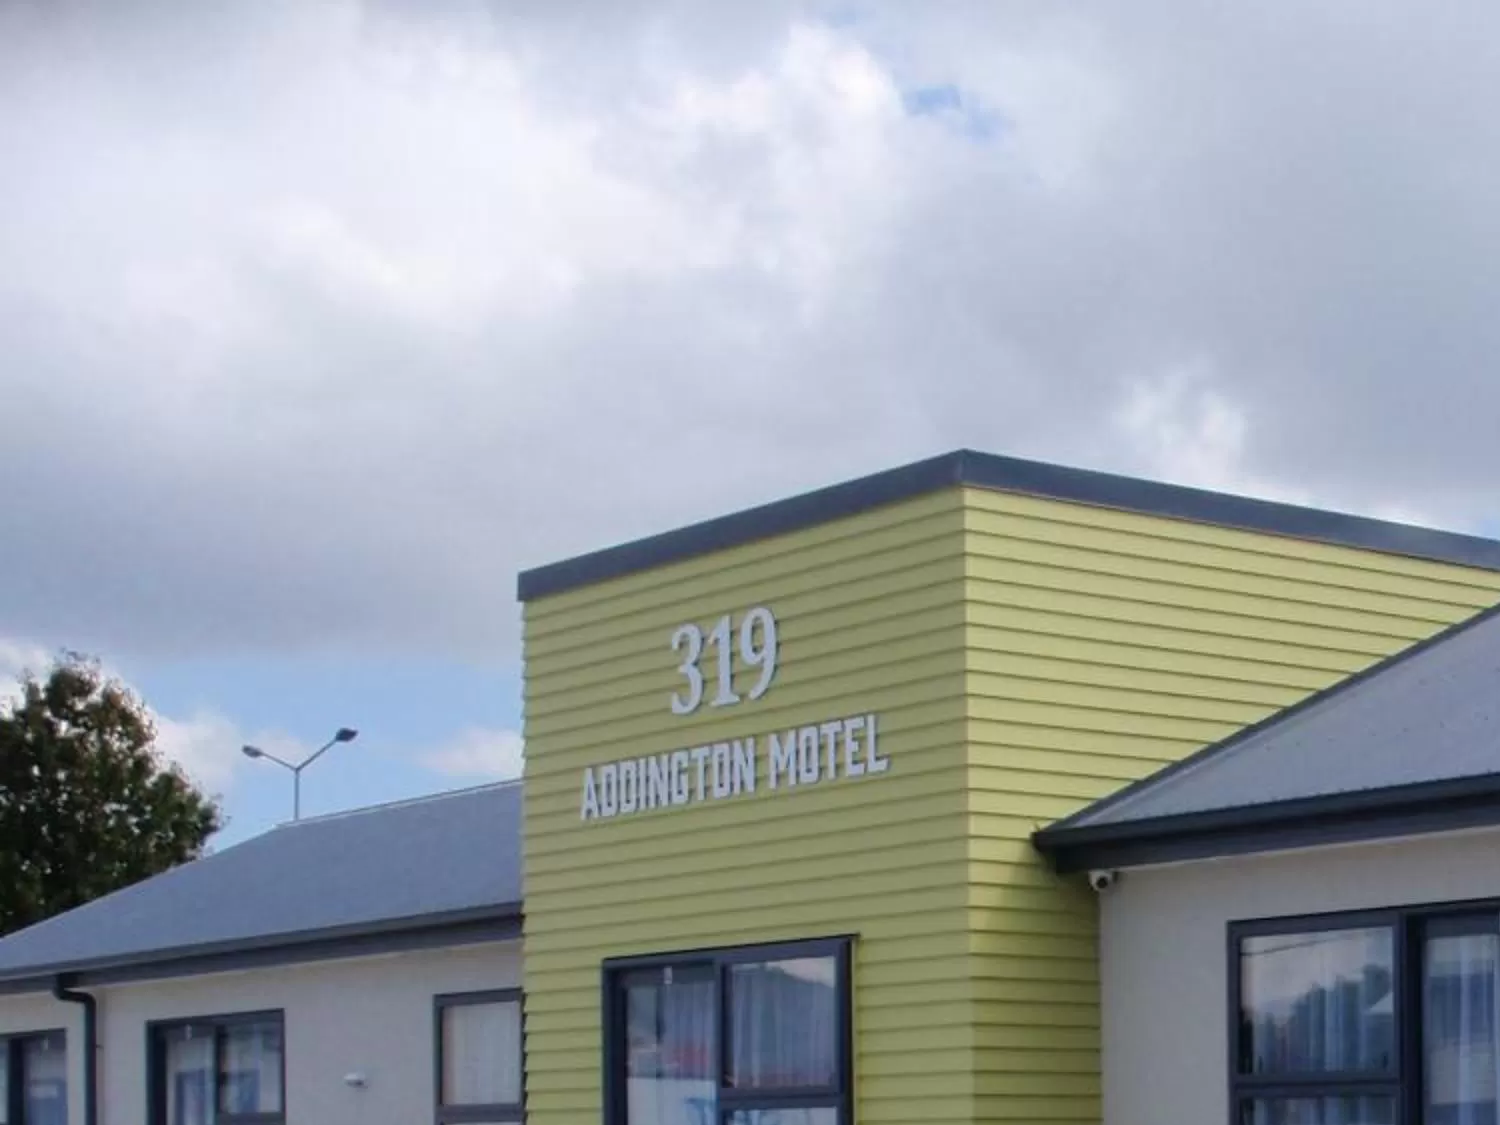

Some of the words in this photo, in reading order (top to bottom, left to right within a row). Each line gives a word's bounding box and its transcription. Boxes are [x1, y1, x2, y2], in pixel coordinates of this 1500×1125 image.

[671, 607, 778, 715] 319
[580, 738, 756, 821] ADDINGTON
[768, 714, 890, 790] MOTEL
